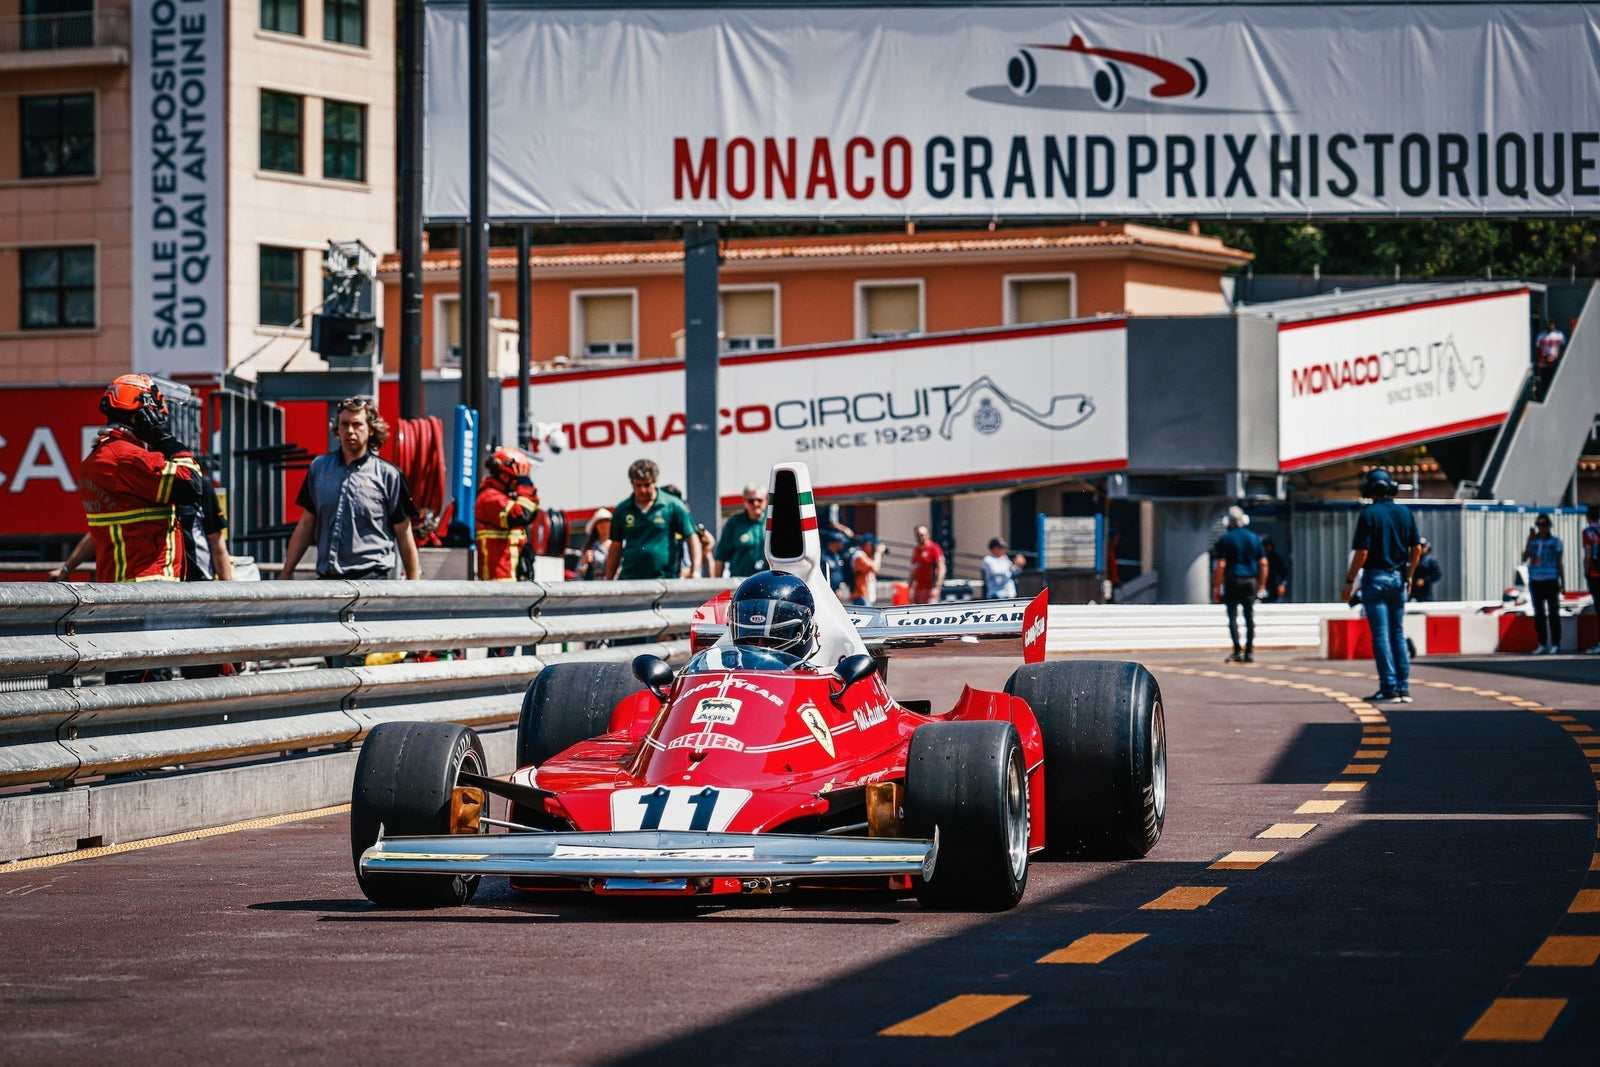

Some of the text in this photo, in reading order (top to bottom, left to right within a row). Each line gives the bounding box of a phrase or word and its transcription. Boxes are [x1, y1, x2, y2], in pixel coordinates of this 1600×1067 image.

[181, 14, 206, 181] ANTOINE
[151, 0, 178, 349] SALLE D'EXPOSITIO
[673, 132, 1600, 200] MONACO GRAND PRIX HISTORIQUE
[181, 195, 210, 284] QUAI
[181, 301, 206, 347] DU
[1291, 354, 1381, 397] MONACO
[774, 385, 961, 431] CIRCUIT
[796, 424, 932, 453] SINCE 1929
[897, 611, 1024, 627] GOODYEAR
[638, 786, 720, 831] 11
